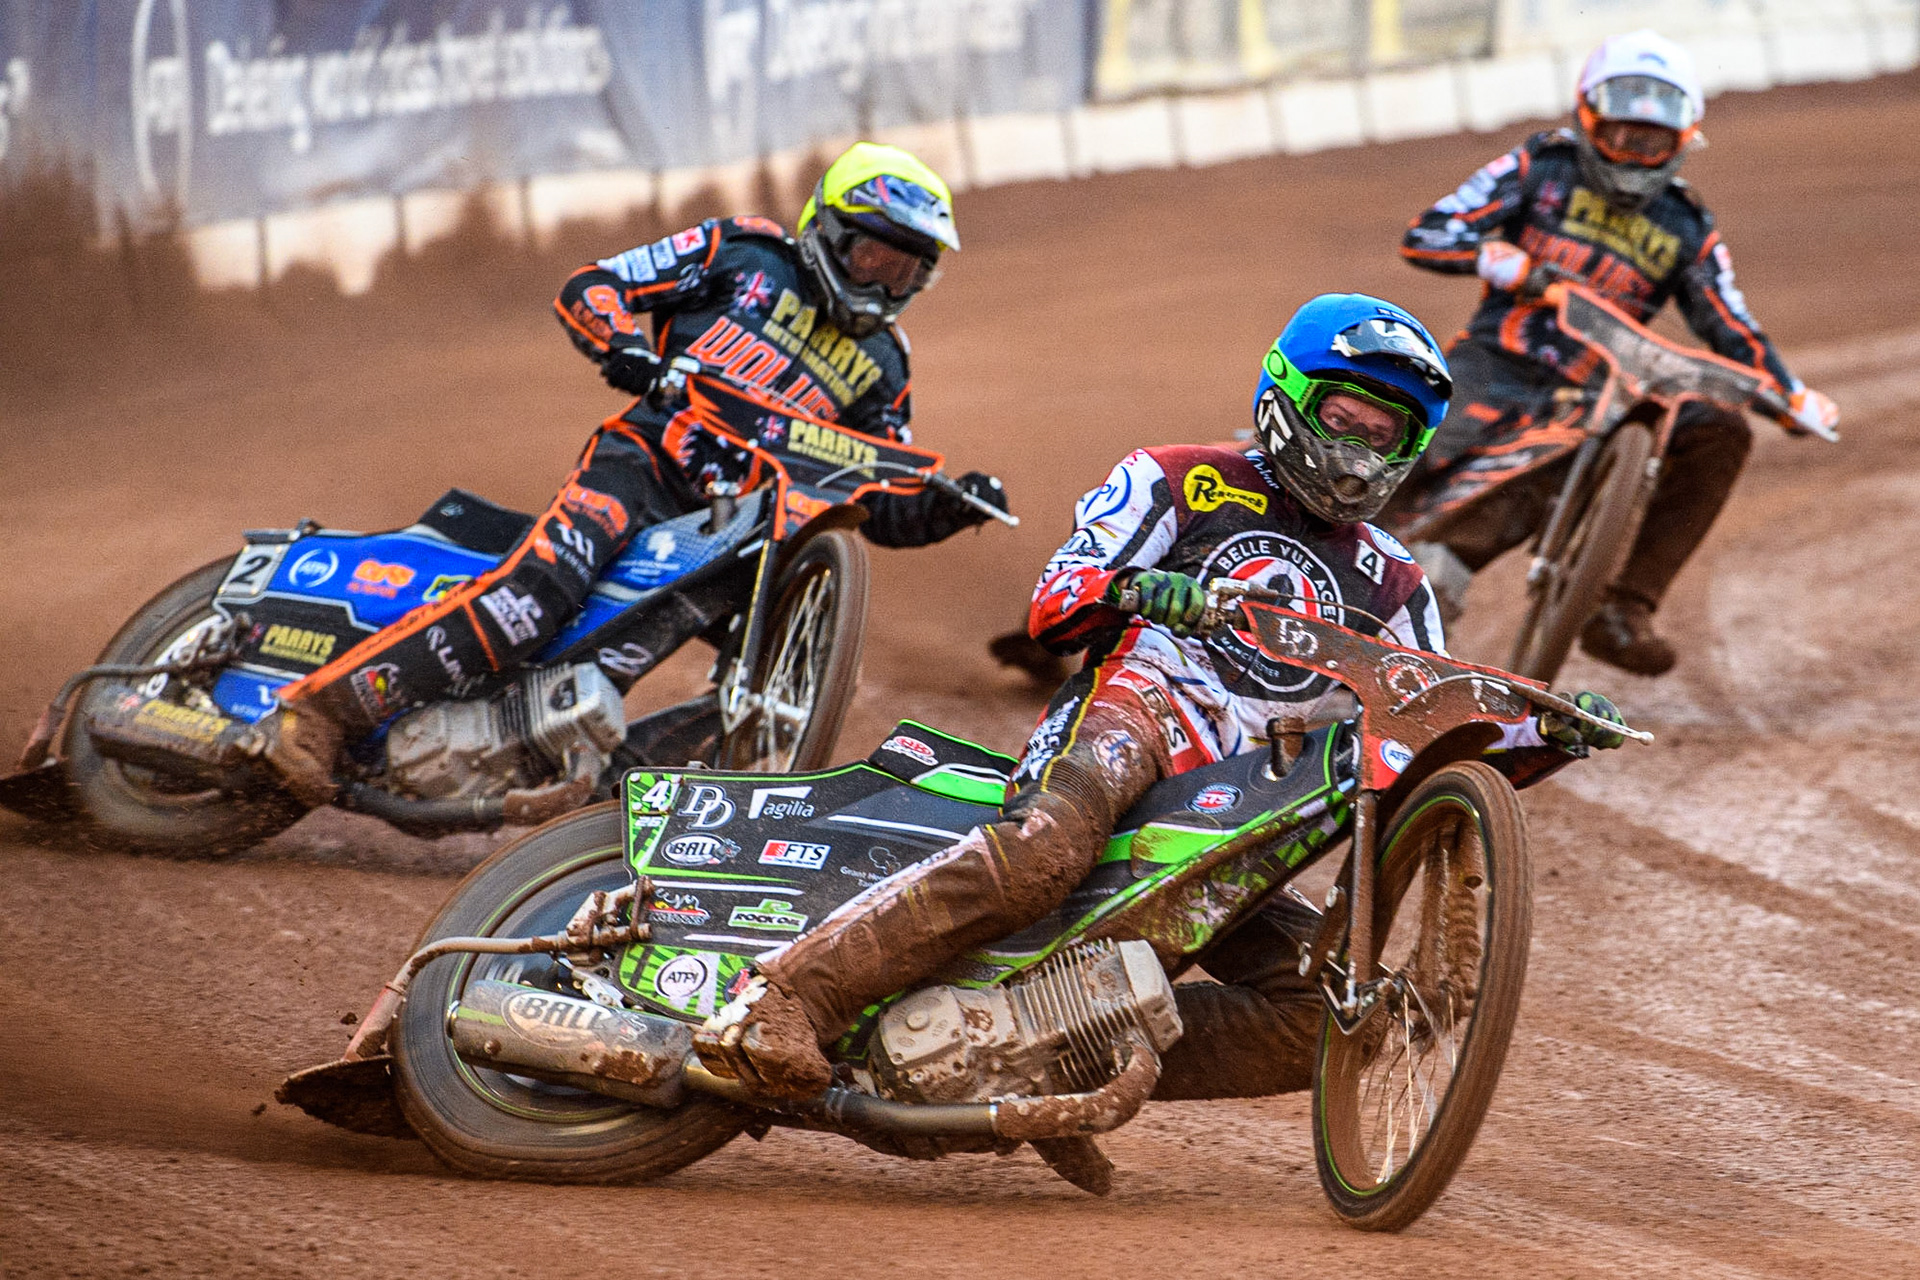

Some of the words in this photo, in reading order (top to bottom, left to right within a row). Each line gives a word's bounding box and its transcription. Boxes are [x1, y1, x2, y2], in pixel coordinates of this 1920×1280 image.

[789, 419, 878, 466] PARRYS
[230, 556, 272, 584] 2
[1216, 539, 1271, 571] BELLE
[1279, 543, 1314, 575] VUE
[1361, 551, 1379, 577] 4
[642, 780, 671, 809] 4
[763, 800, 815, 820] agilia
[784, 843, 825, 861] FTS
[734, 913, 775, 924] ROCK
[665, 970, 700, 985] ATPI
